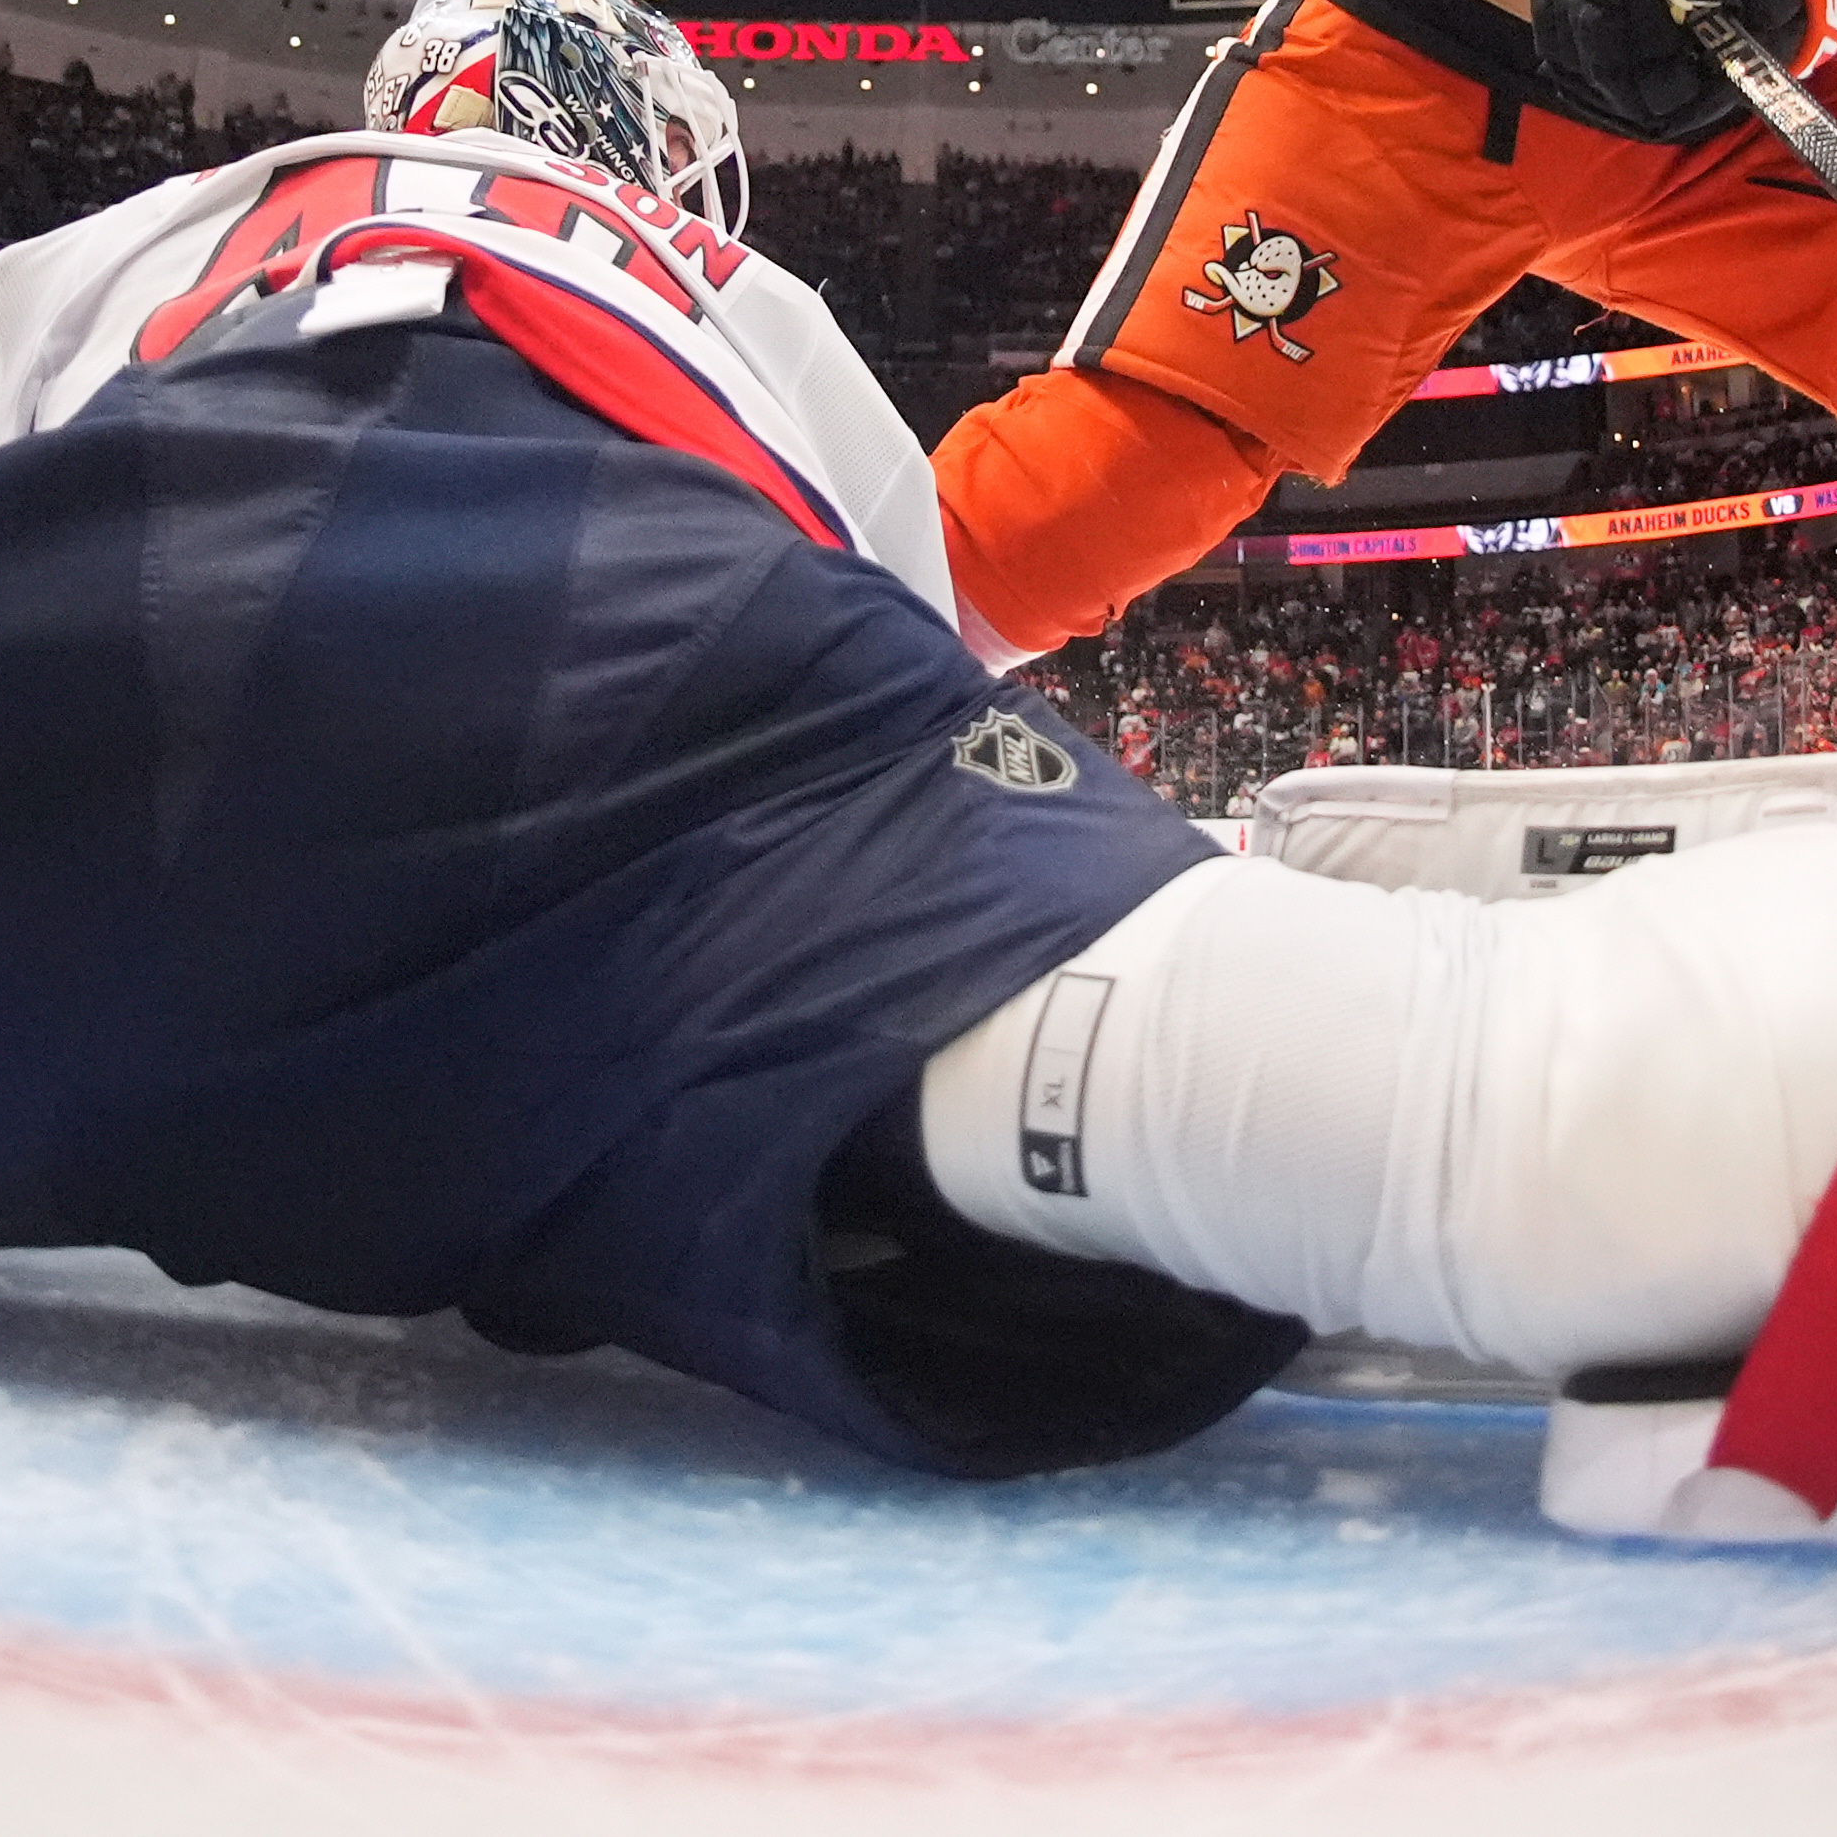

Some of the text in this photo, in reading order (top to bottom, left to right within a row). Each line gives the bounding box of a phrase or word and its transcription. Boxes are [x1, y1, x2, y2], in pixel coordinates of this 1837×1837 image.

[421, 39, 464, 75] 38
[675, 20, 970, 63] HONDA
[1008, 16, 1172, 64] Center
[381, 74, 411, 115] 57
[1607, 512, 1687, 538] ANAHEIM
[1691, 501, 1751, 527] DUCKS
[1769, 494, 1797, 516] VS
[1003, 734, 1034, 782] NHL
[1040, 1076, 1066, 1108] XL
